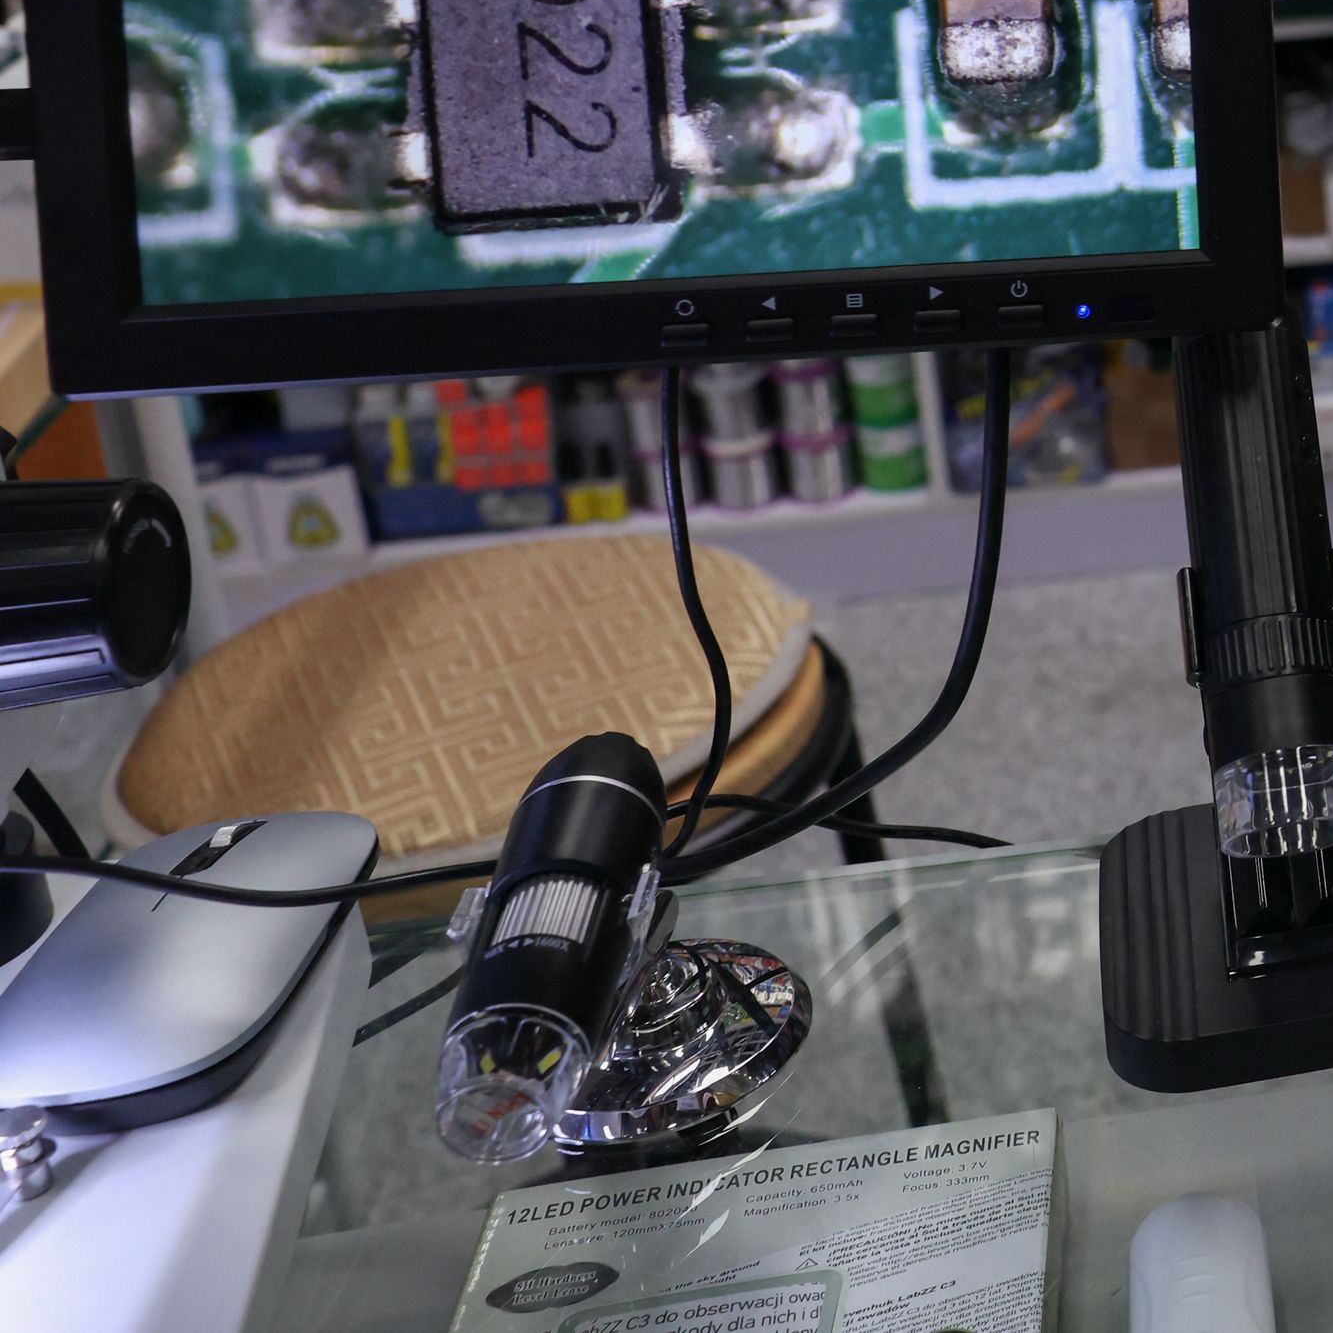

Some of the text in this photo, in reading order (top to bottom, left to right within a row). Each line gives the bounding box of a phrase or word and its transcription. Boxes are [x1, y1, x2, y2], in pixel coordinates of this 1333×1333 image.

[507, 1202, 574, 1226] 12LED
[580, 1186, 661, 1214] POWER
[790, 1147, 917, 1180] RECTANGLE
[924, 1129, 1040, 1160] MAGNIFIER
[903, 1160, 988, 1180] Voltage: 3.7V
[810, 1179, 863, 1195] 650mAh
[902, 1175, 990, 1193] Focus: 333mm
[936, 1215, 967, 1225] mires
[970, 1204, 1002, 1216] nunca
[548, 1219, 597, 1237] Battery
[826, 1252, 853, 1263] cielo
[856, 1238, 905, 1255] cercanas
[922, 1226, 939, 1235] Sol
[952, 1214, 985, 1227] través
[1004, 1203, 1024, 1211] una
[885, 1241, 911, 1252] vista
[924, 1227, 963, 1242] incluso
[966, 1212, 1014, 1230] quedarte
[909, 1238, 949, 1254] defectos
[983, 1215, 1034, 1232] materiales
[902, 1253, 942, 1267] derecho
[952, 1236, 997, 1252] modificar
[1009, 1224, 1038, 1235] retirar
[538, 1270, 598, 1288] Hardness
[697, 1271, 720, 1286] sky
[721, 1260, 761, 1279] around
[898, 1280, 956, 1302] LabZZ C3
[922, 1303, 936, 1311] do
[938, 1285, 994, 1307] obserwacji
[996, 1271, 1039, 1287] owadów
[941, 1287, 1031, 1318] owadów pozwala
[626, 1314, 650, 1331] C3
[655, 1309, 678, 1325] do
[684, 1290, 785, 1319] obserwacji
[727, 1314, 758, 1332] dla
[761, 1308, 797, 1327] nich
[857, 1301, 910, 1322] owadów
[900, 1311, 931, 1324] wieku
[955, 1312, 971, 1320] dla
